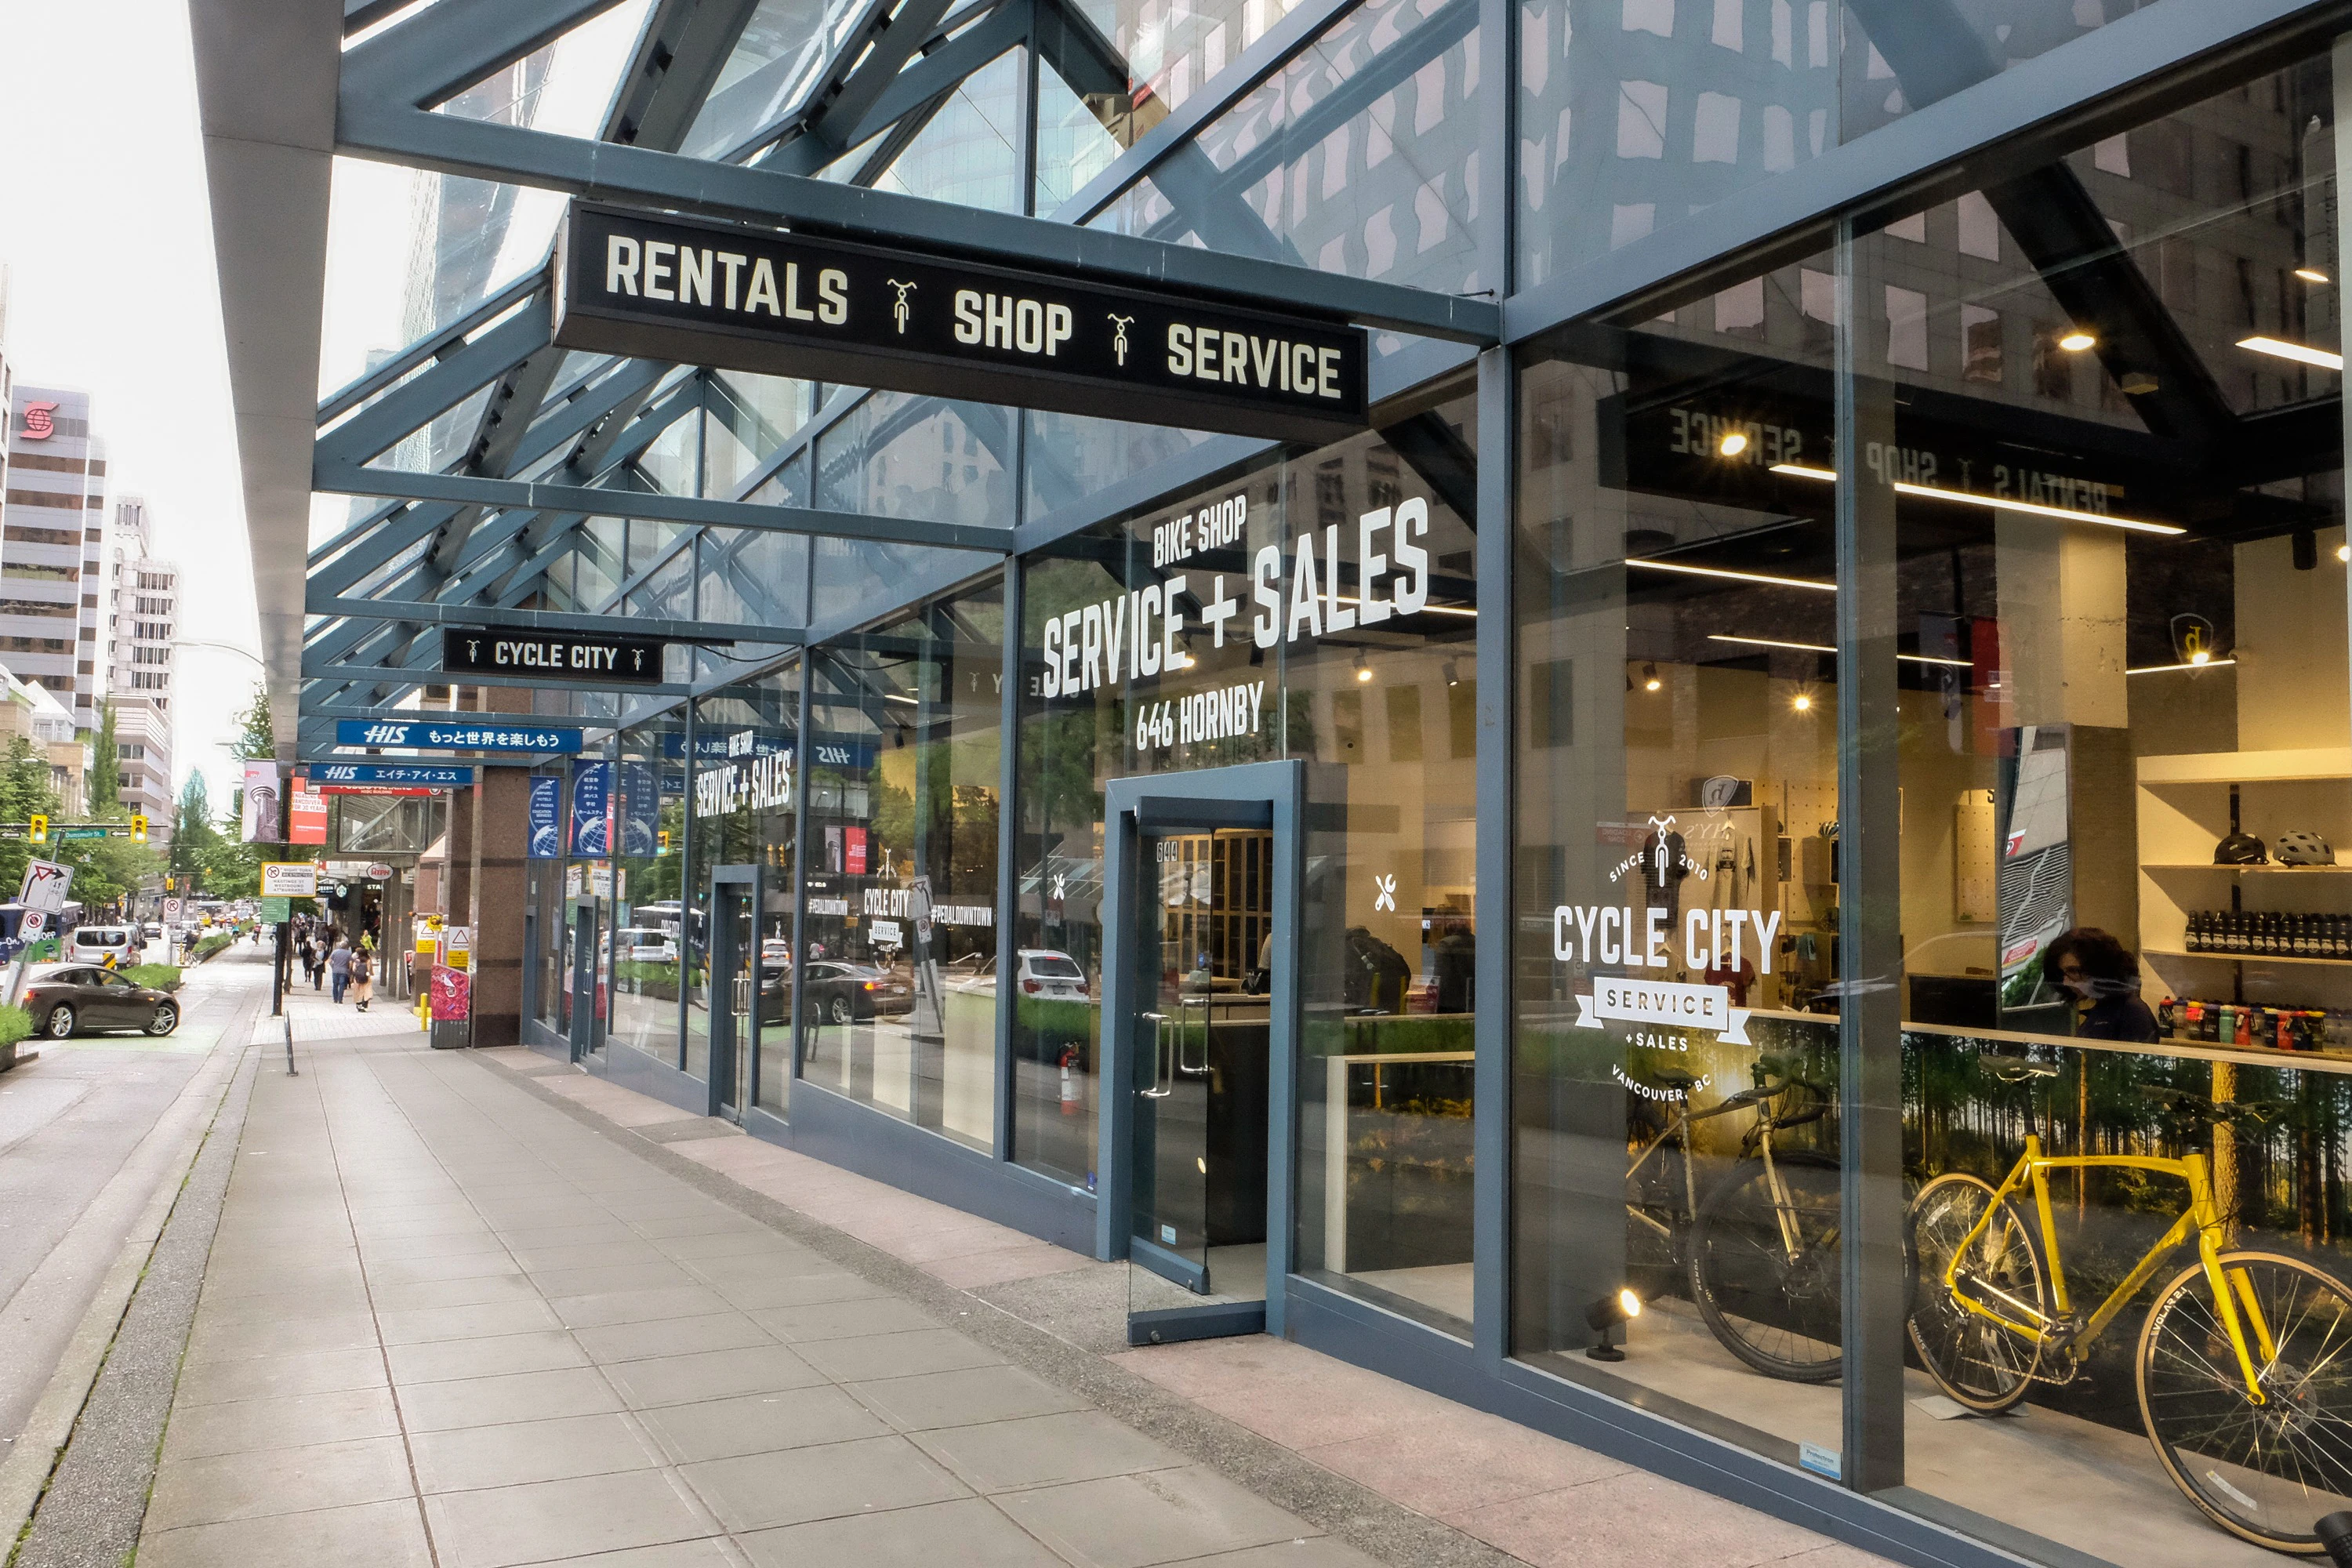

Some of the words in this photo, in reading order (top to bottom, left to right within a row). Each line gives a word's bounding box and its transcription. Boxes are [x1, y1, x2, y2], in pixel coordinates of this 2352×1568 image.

[606, 234, 848, 325] RENTALS
[954, 289, 1073, 357] SHOP
[1167, 323, 1342, 399] SERVICE
[1153, 515, 1192, 568] BIKE
[1198, 494, 1247, 553] SHOP
[1043, 575, 1187, 699] SERVICE
[1254, 496, 1428, 648] SALES
[495, 641, 564, 667] CYCLE
[570, 645, 618, 670] CITY
[1136, 699, 1173, 751] 646
[1180, 680, 1265, 744] HORNBY
[364, 724, 409, 744] HIS
[429, 730, 560, 748] もっと世界を楽しもう
[325, 765, 358, 780] HIS
[376, 768, 458, 781] エイチ・アイ・エス
[696, 764, 738, 818] SERVICE
[751, 750, 791, 811] SALES
[1157, 842, 1178, 862] 644
[1610, 851, 1645, 883] SINCE
[1678, 854, 1708, 880] 2010
[808, 898, 848, 916] #PEDALDOWNTOWN
[864, 887, 888, 916] CYCLE
[891, 888, 910, 917] CITY
[931, 904, 993, 927] #PEDALDOWNTOWN
[874, 925, 897, 937] SERVICE
[1553, 905, 1668, 967] CYCLE
[1686, 908, 1782, 975] CITY
[1606, 989, 1714, 1017] SERVICE
[1693, 1073, 1712, 1094] BC
[2152, 1298, 2176, 1330] VOLAR
[2172, 1286, 2188, 1299] 2.1
